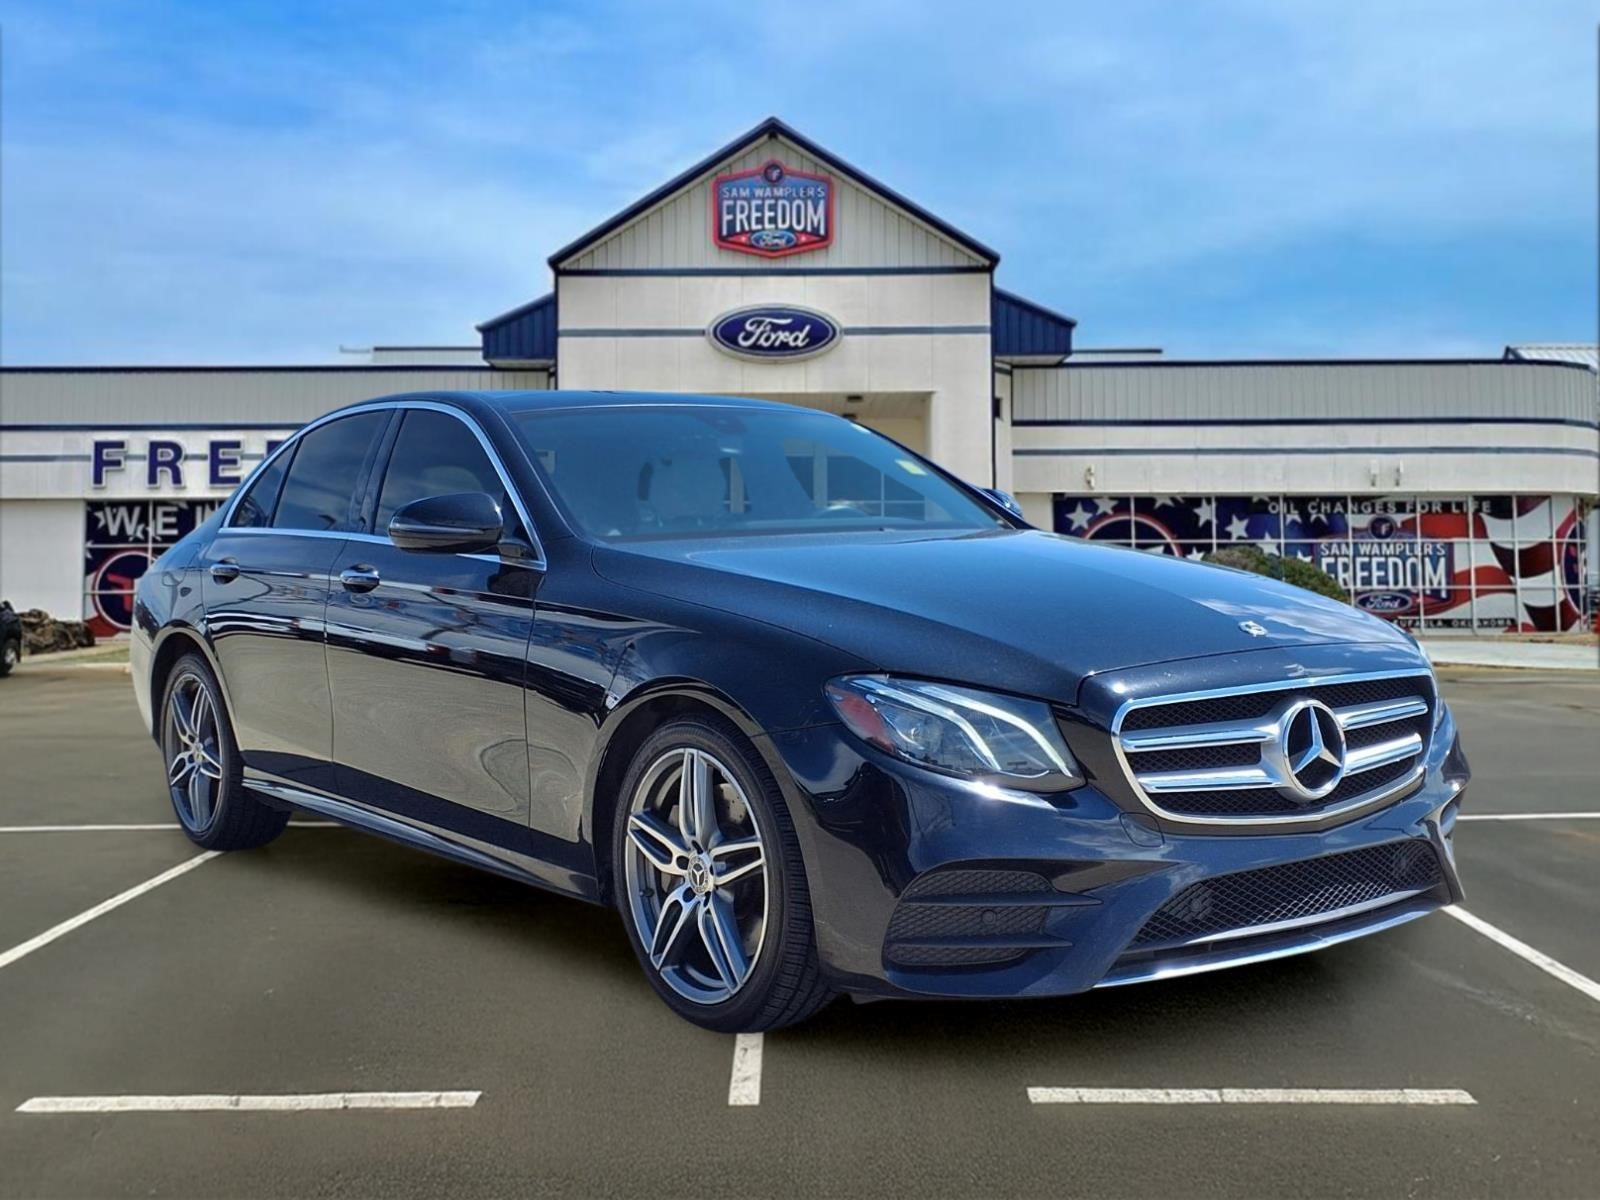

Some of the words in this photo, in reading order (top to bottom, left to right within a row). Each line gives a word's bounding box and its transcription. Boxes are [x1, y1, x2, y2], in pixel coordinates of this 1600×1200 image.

[722, 187, 750, 198] SAM
[722, 201, 825, 236] FREEDOM
[759, 233, 787, 247] Ford
[737, 317, 810, 348] Ford
[93, 440, 284, 486] FRE
[1268, 502, 1299, 514] OIL
[1307, 501, 1396, 513] CHANGES
[1406, 501, 1442, 513] FOR
[1451, 501, 1491, 513] LIFE
[1320, 557, 1447, 598] FREEDOM
[1365, 595, 1400, 609] Ford
